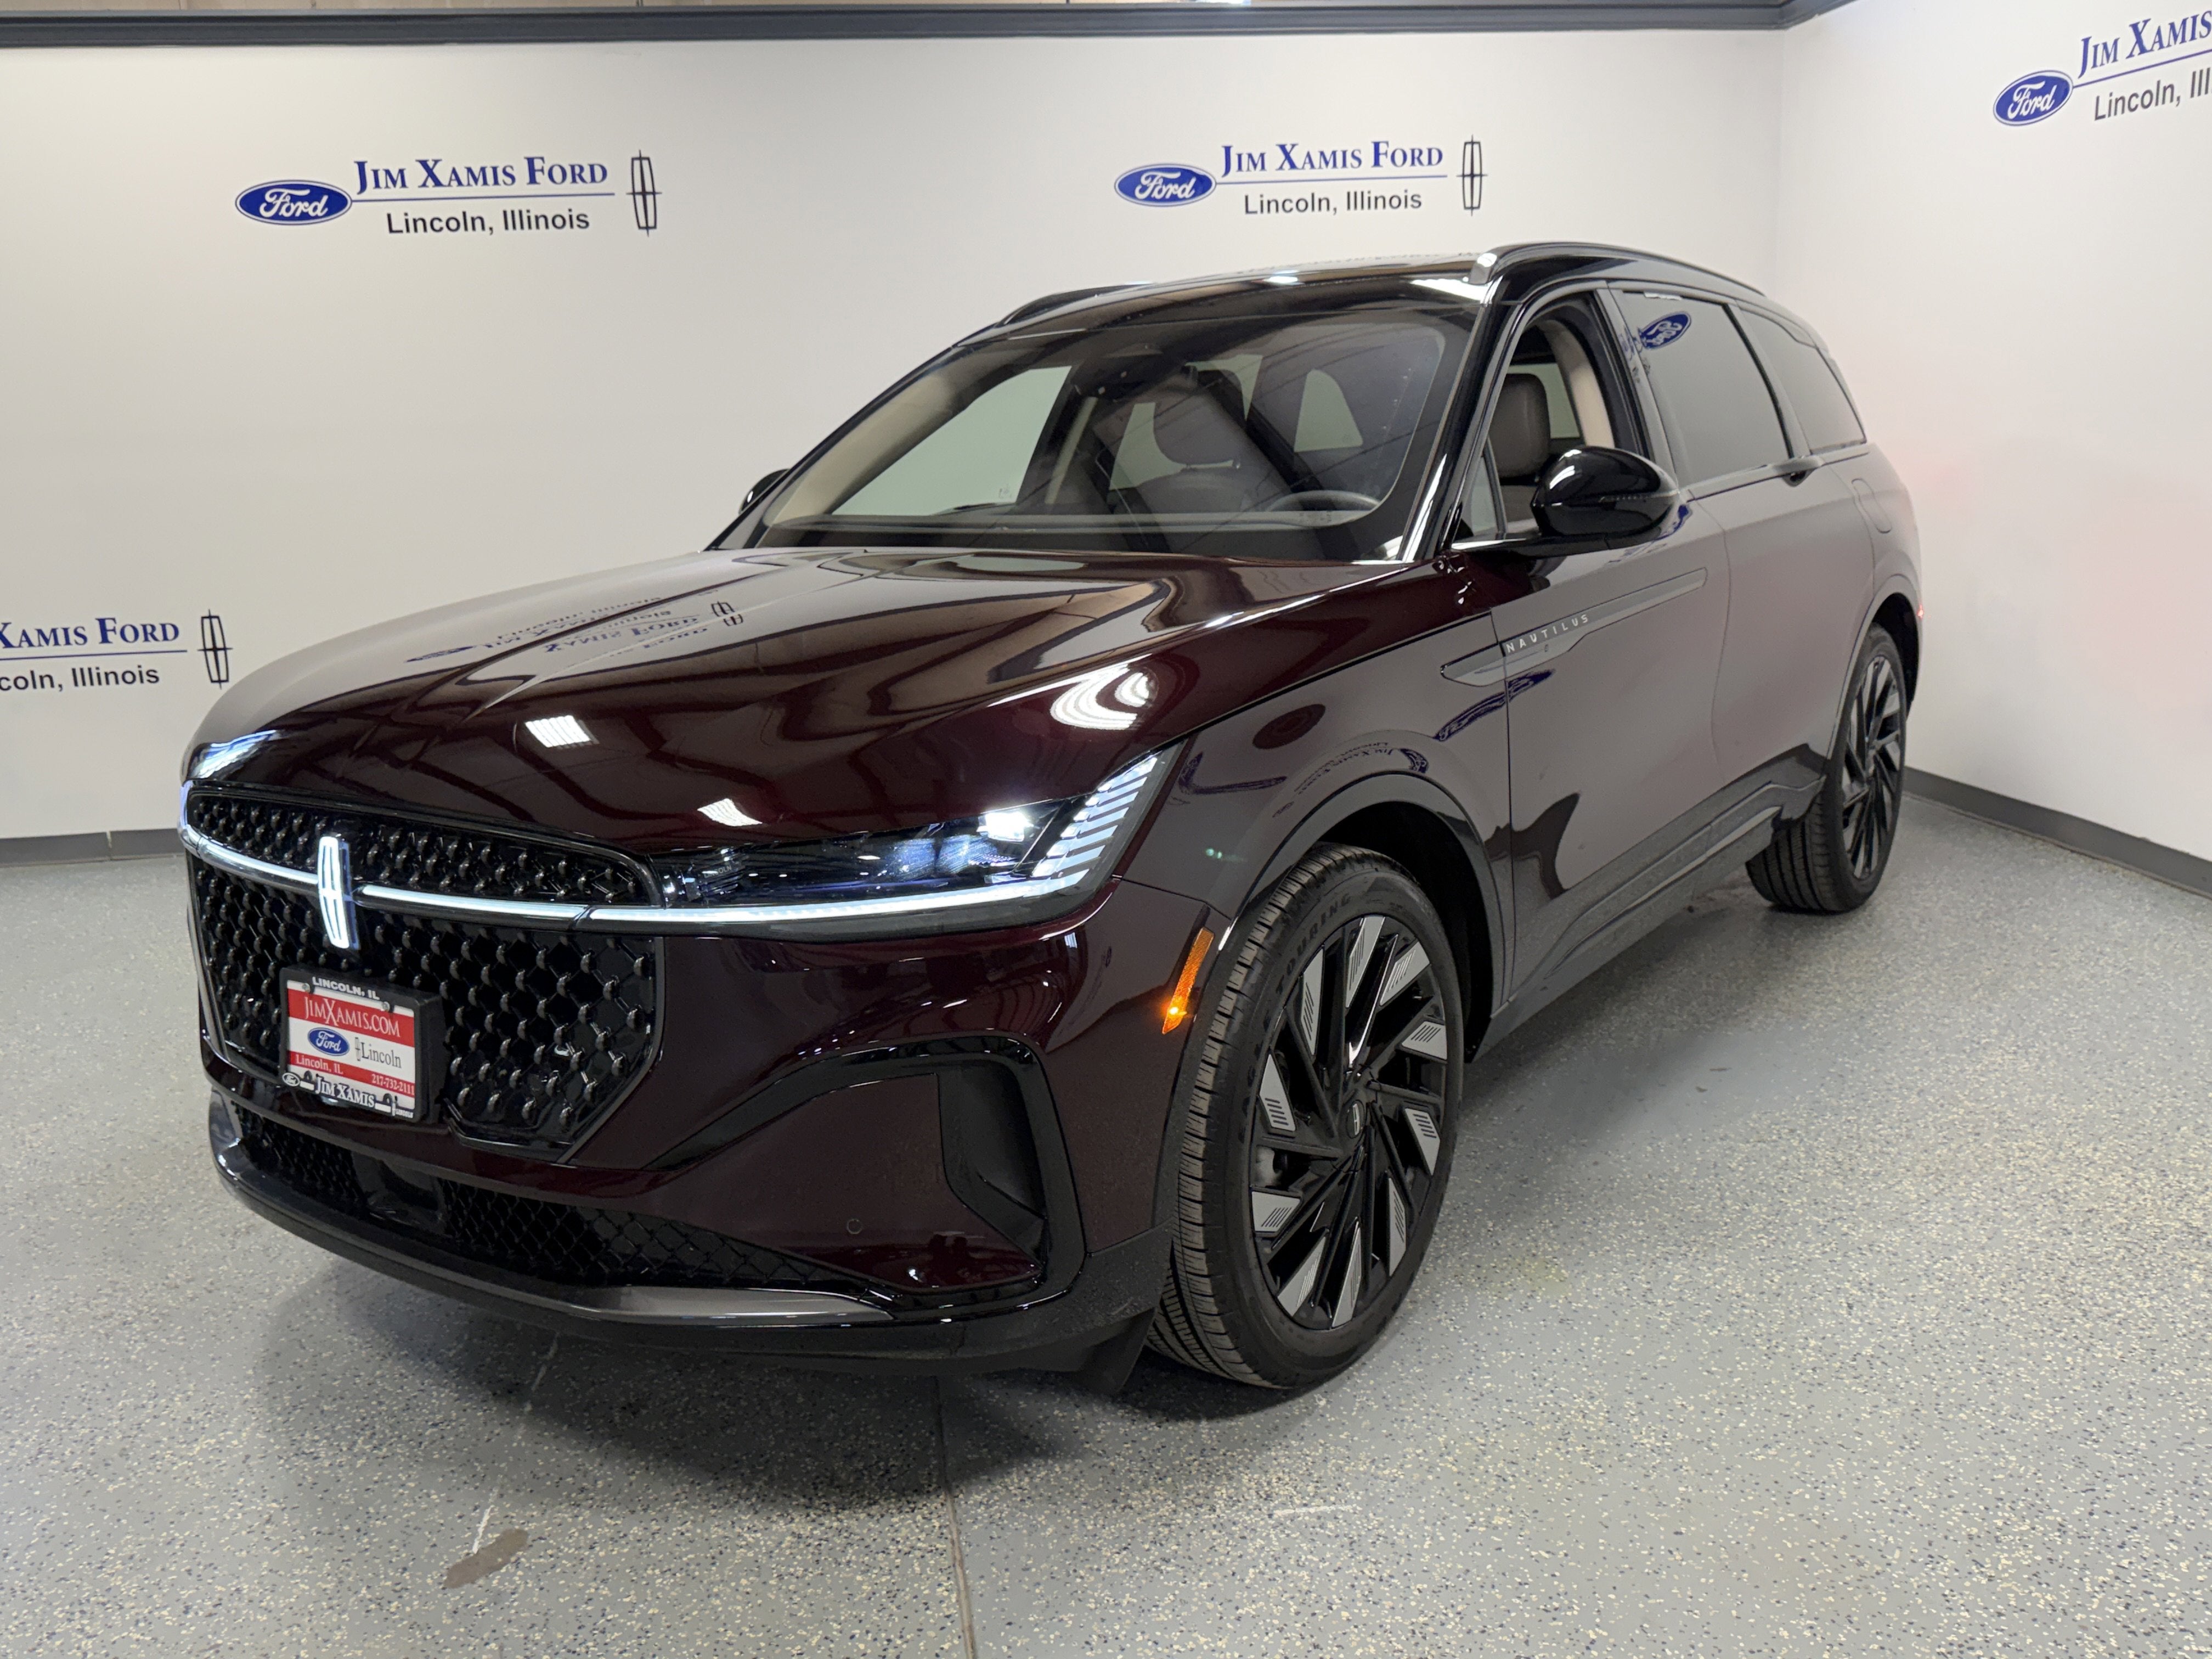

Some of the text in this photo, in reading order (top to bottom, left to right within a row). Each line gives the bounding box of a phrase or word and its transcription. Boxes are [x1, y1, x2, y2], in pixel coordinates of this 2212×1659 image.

[2078, 10, 2212, 78] JIM XAMIS
[2007, 80, 2057, 120] Ford
[2095, 67, 2212, 121] Lincoln, Ill
[1221, 141, 1443, 178] JIM XAMIS FORD
[354, 156, 608, 195] JIM XAMIS FORD
[1135, 171, 1196, 200] Ford
[258, 188, 328, 219] Ford
[1245, 190, 1421, 215] Lincoln, Illinois
[387, 208, 590, 235] Lincoln, Illinois
[95, 617, 179, 644] FORD
[1506, 614, 1589, 653] NAUTILUS
[71, 665, 160, 687] Illinois
[1276, 893, 1351, 995] TOURING
[312, 977, 380, 1000] LINCOLN, IL
[304, 996, 400, 1037] JIMXAMIS.COM
[315, 1031, 341, 1052] Ford
[361, 1042, 402, 1068] Lincoln
[296, 1054, 343, 1075] Lincoln, IL
[315, 1076, 375, 1108] JIM XAMIS
[371, 1074, 415, 1096] 217-732-2111
